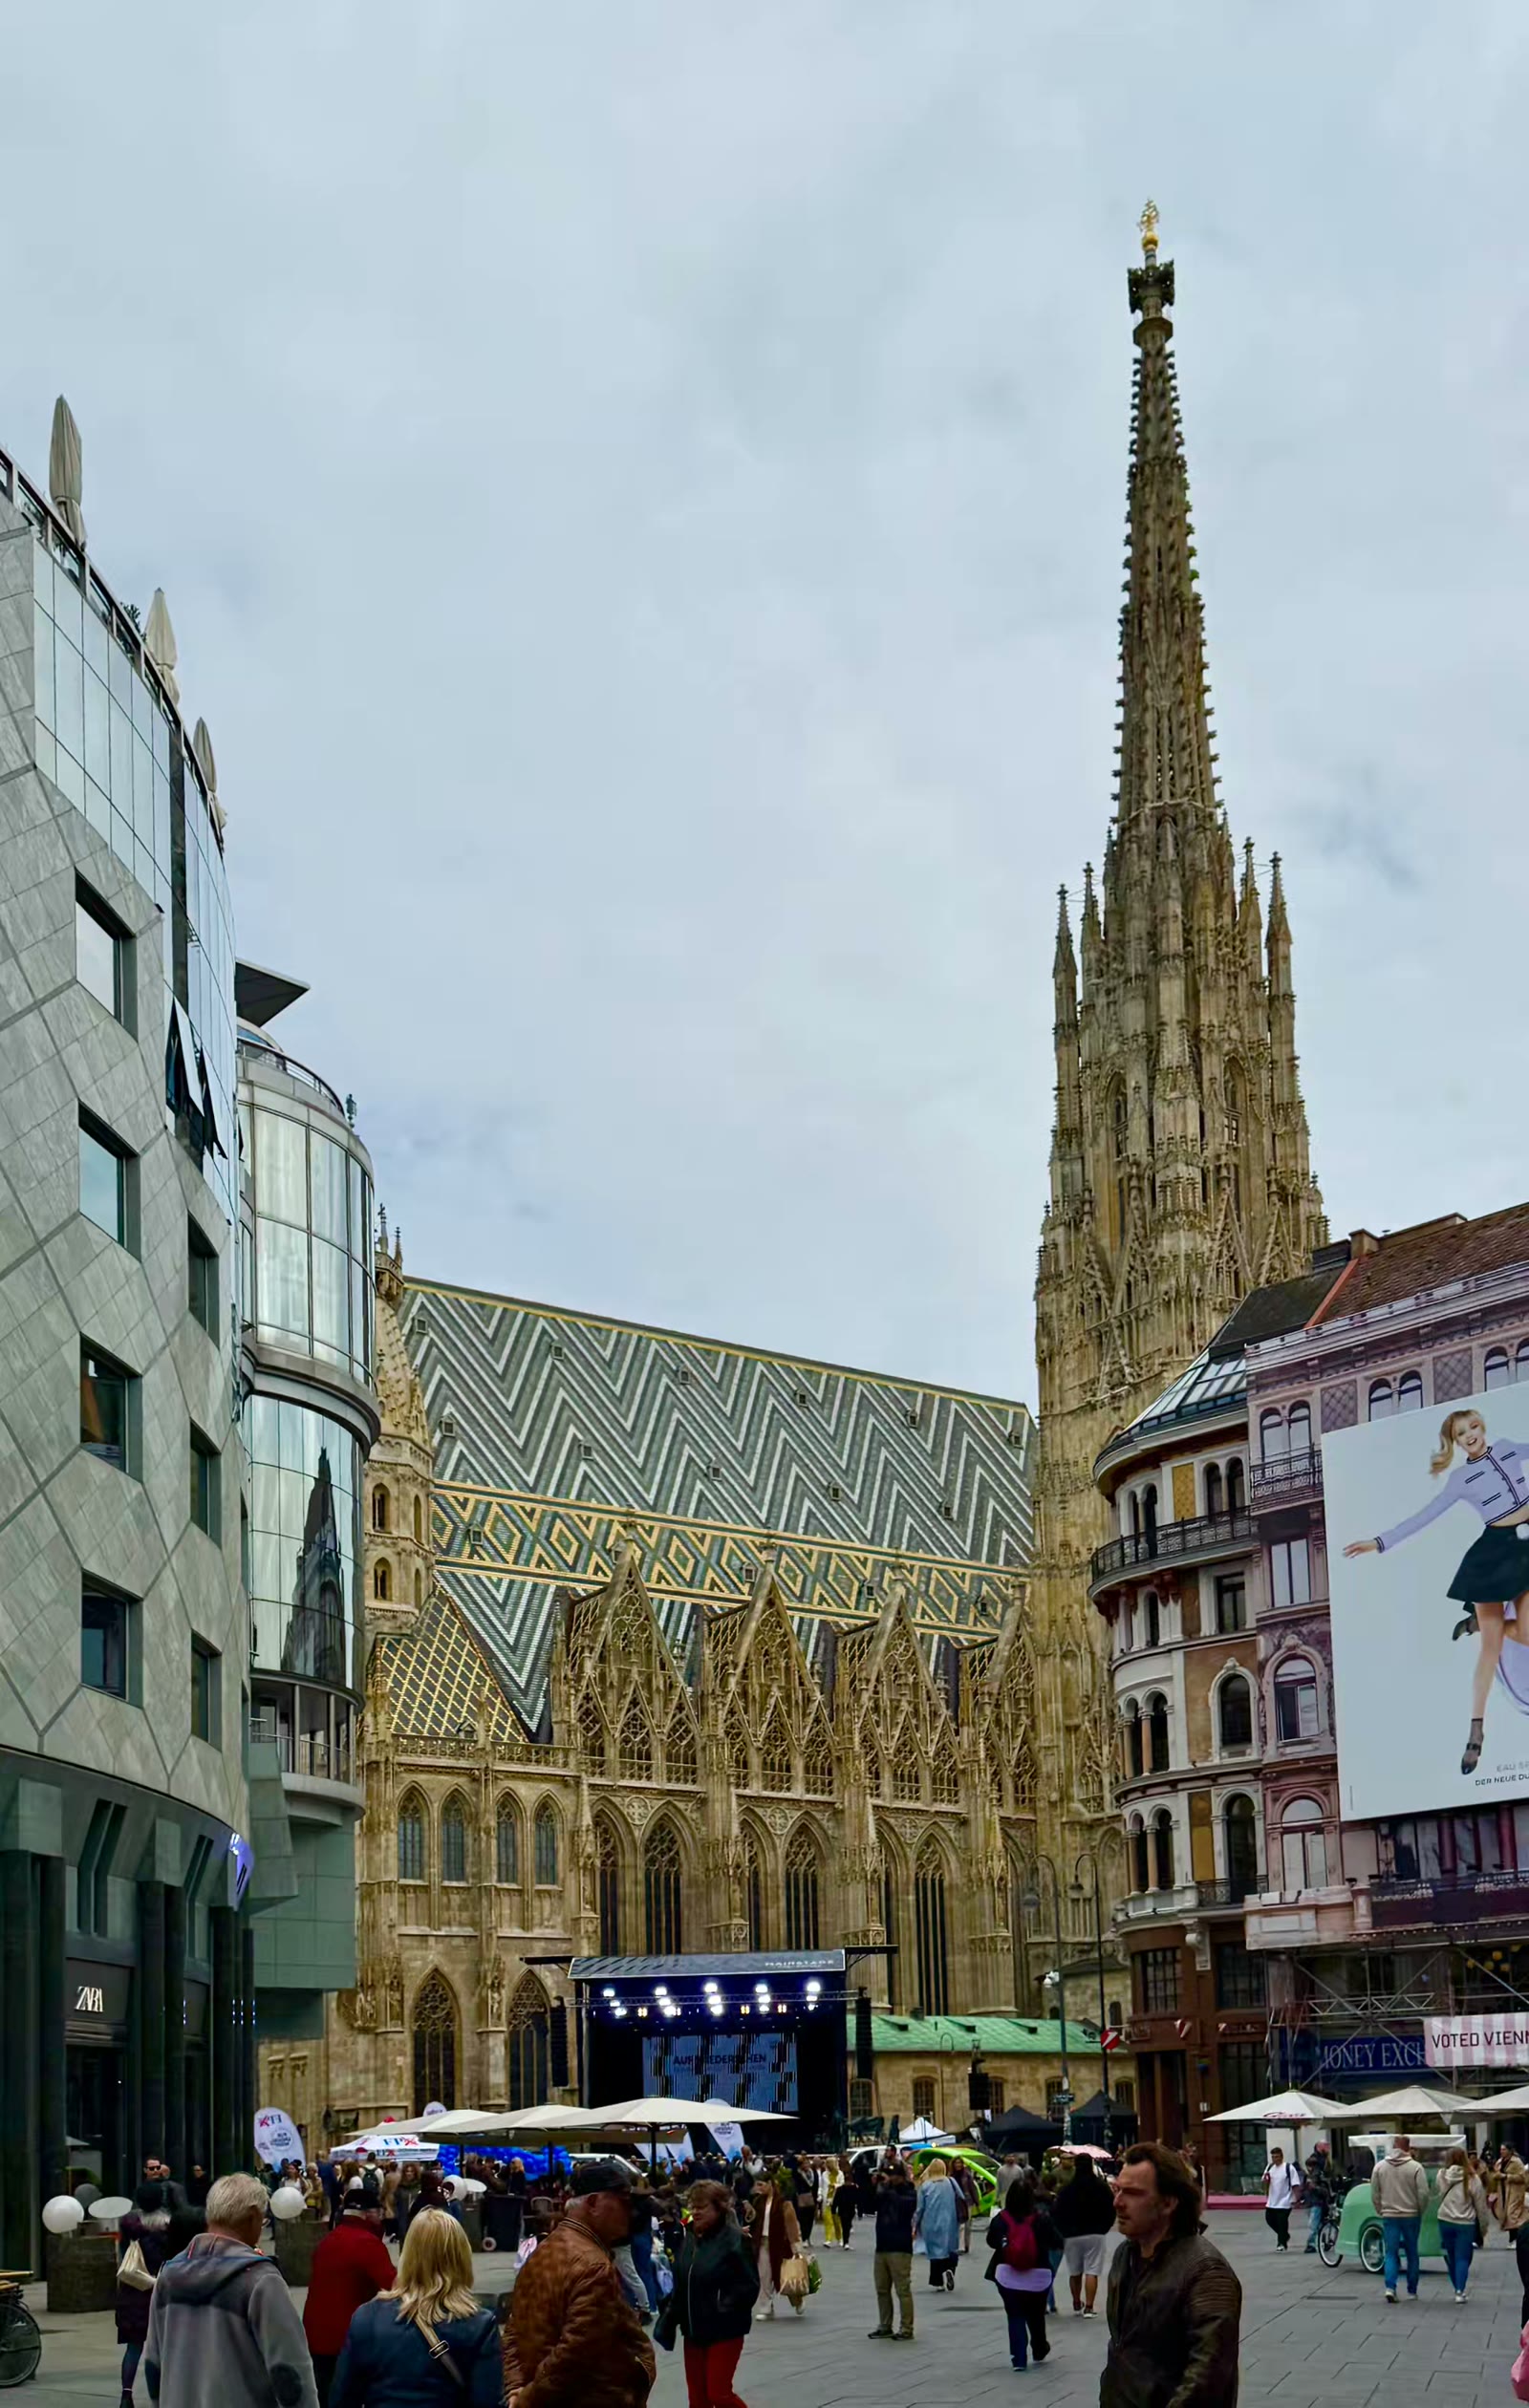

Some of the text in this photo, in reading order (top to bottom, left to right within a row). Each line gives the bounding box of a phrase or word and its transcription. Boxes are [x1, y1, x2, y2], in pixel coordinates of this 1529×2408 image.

[1475, 1777, 1492, 1786] DER
[1494, 1774, 1517, 1784] NEUE
[75, 1986, 103, 2012] ZARA
[1432, 2032, 1479, 2049] VOTED
